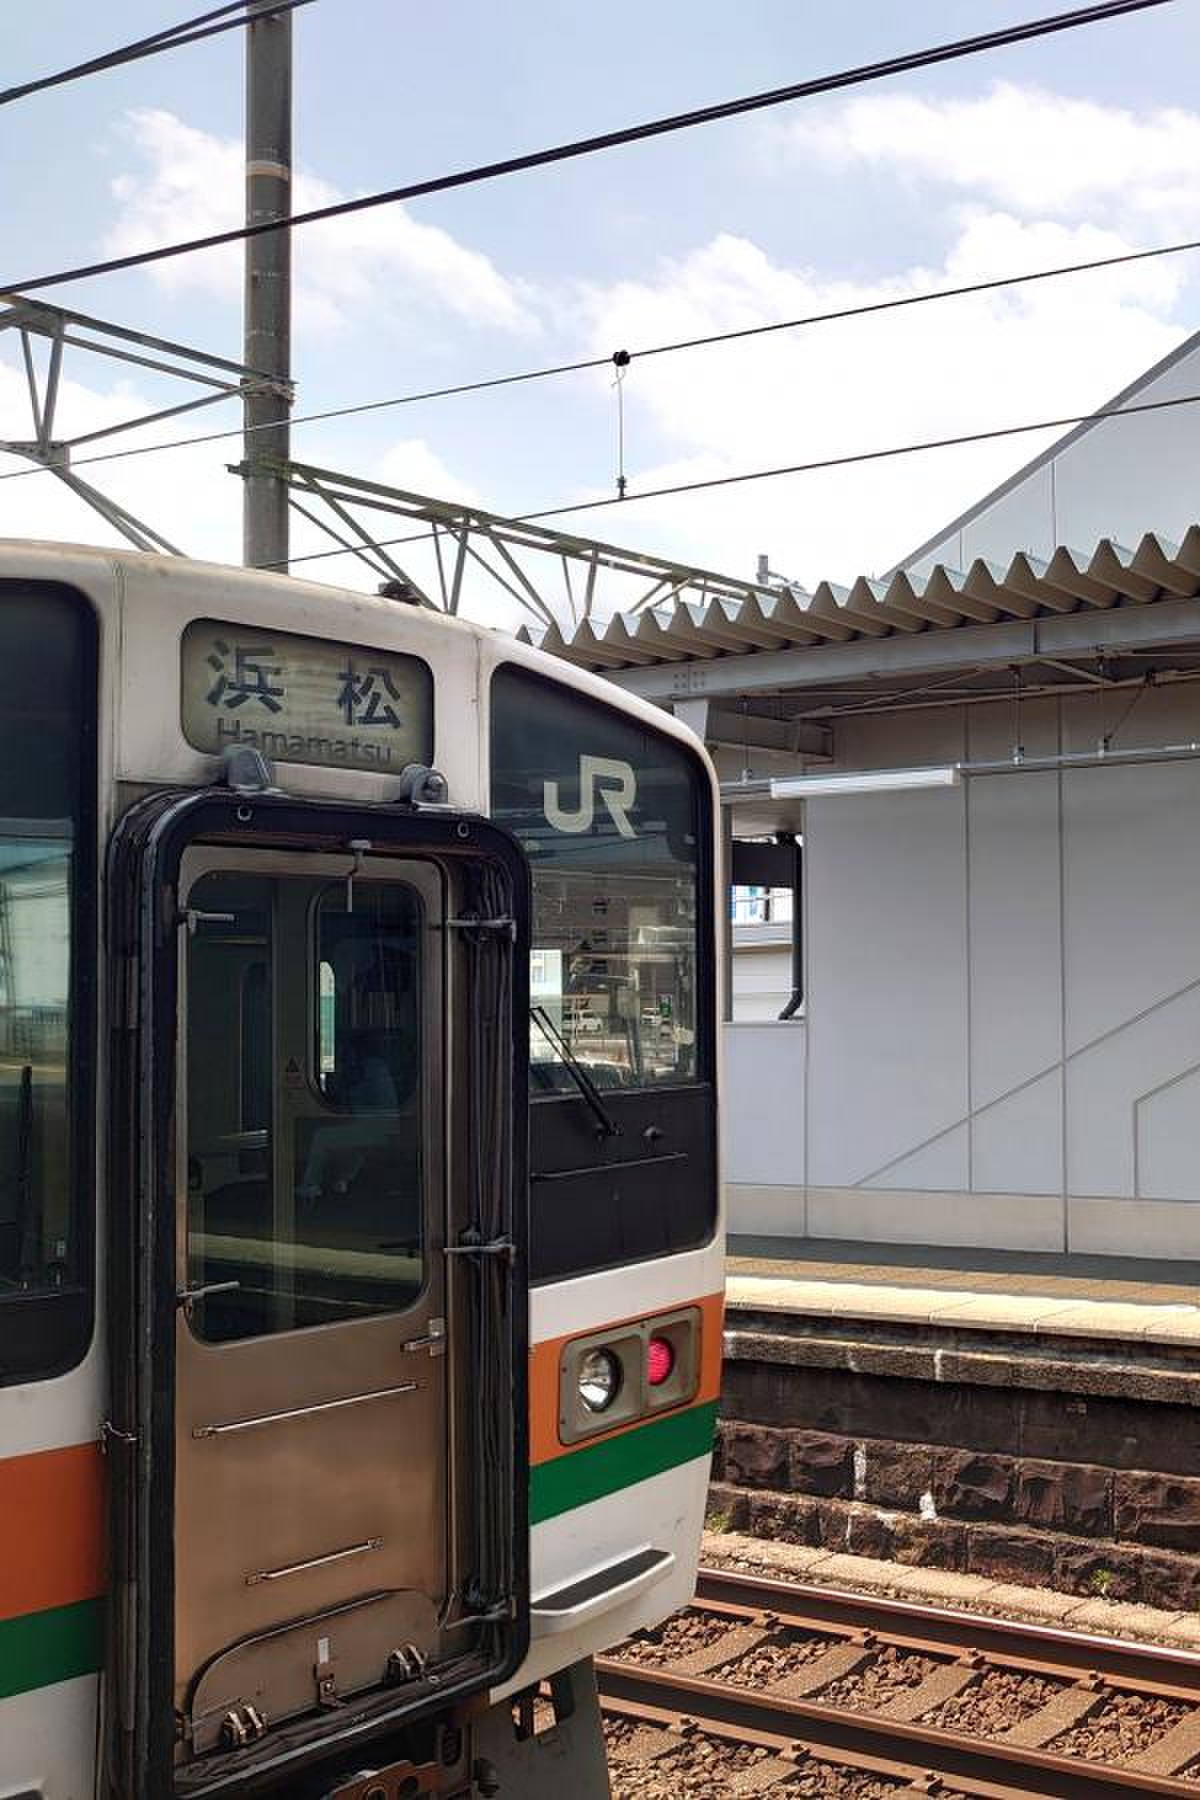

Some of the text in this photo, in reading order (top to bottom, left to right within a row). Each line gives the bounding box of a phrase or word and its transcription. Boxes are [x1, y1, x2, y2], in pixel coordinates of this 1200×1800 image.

[205, 639, 402, 730] 浜松
[217, 718, 392, 765] Hamamatsu
[543, 754, 638, 839] JR
